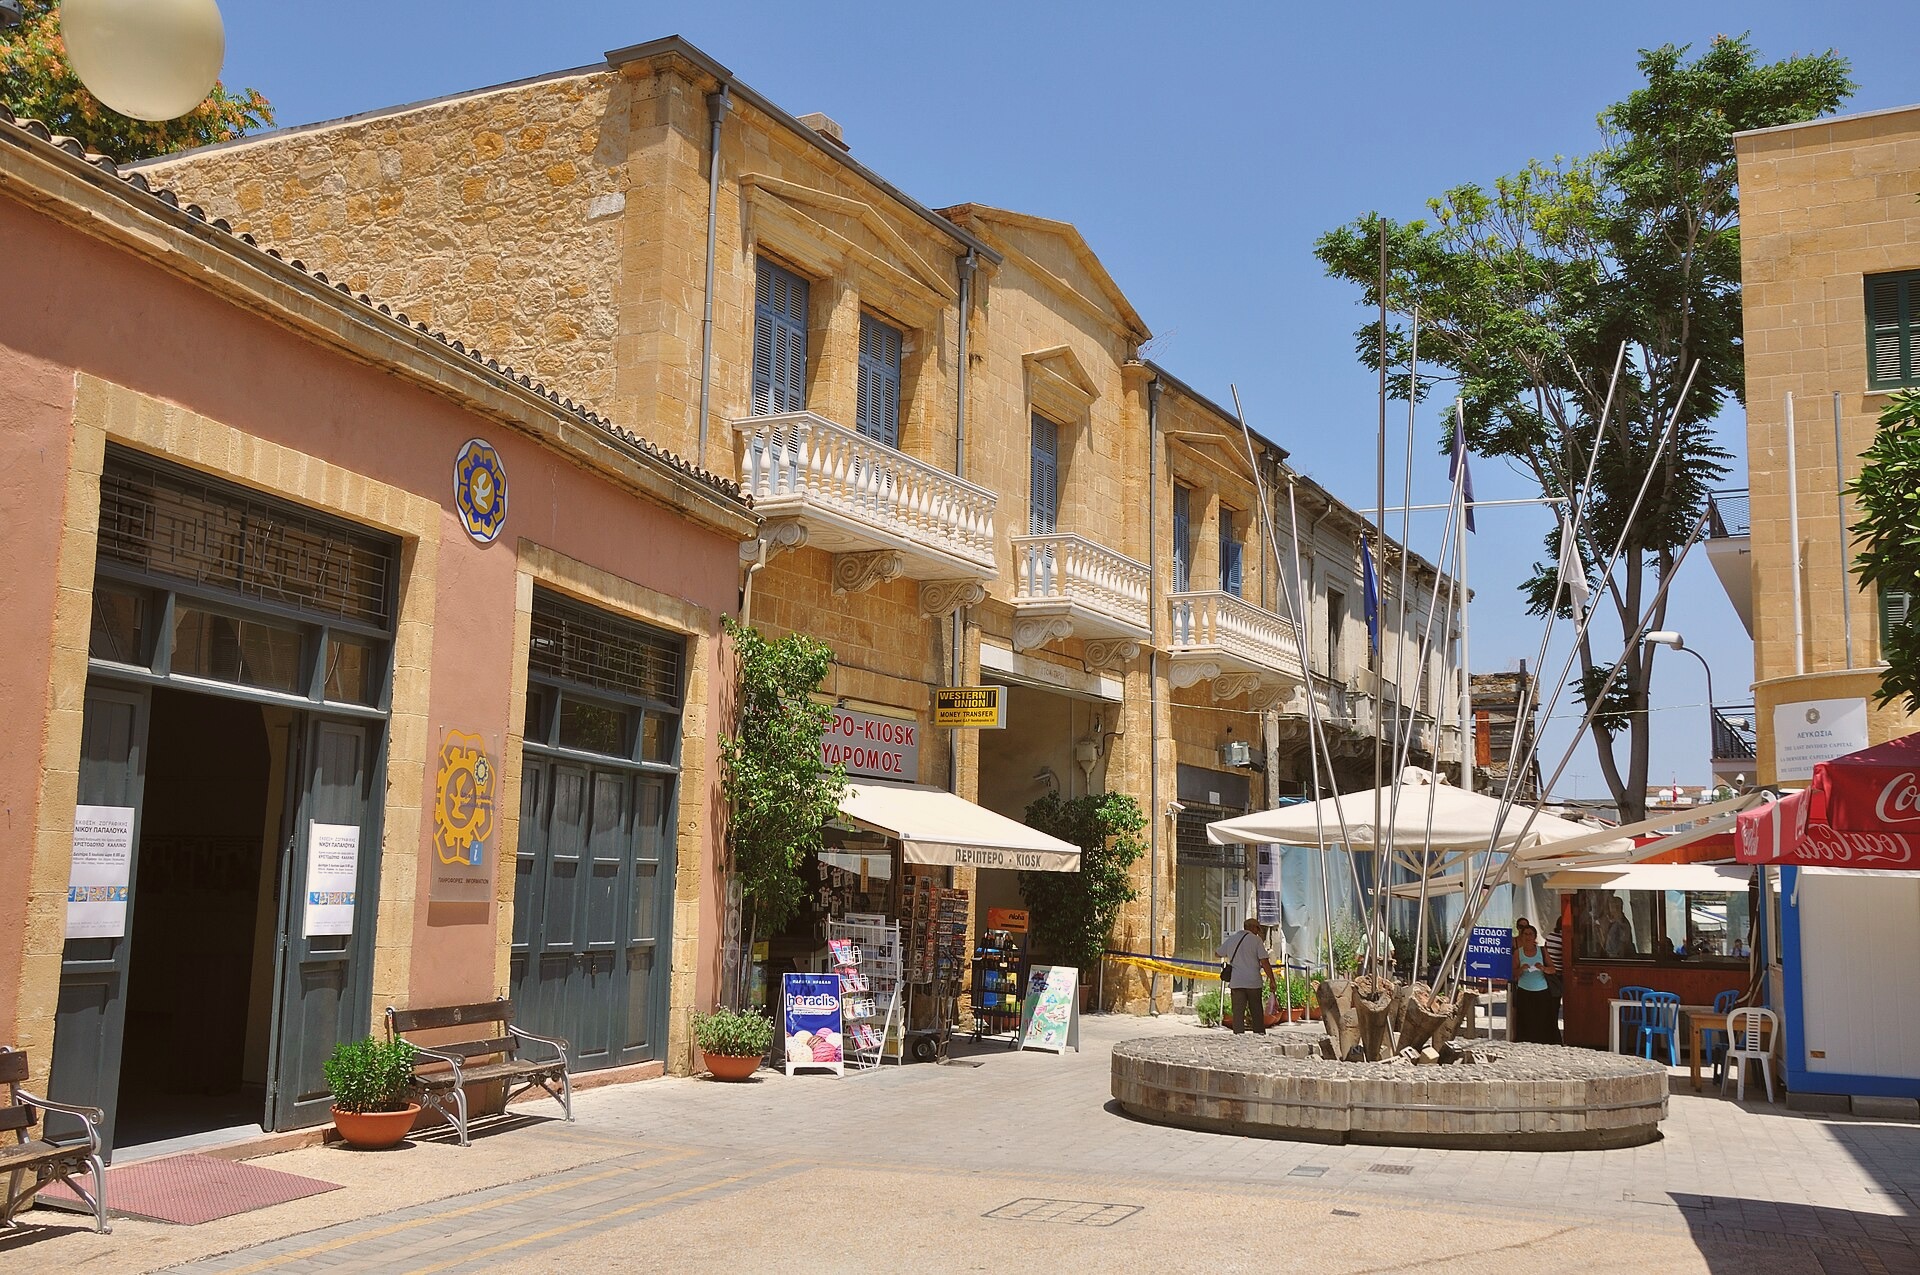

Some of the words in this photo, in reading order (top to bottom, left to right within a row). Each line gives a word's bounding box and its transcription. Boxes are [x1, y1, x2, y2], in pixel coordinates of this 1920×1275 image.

[939, 691, 986, 700] WESTERN
[954, 699, 986, 708] UNION
[821, 714, 915, 746] ΕΡΟ-KIOSK
[1797, 730, 1833, 739] ΛΕΥΚΩΣΙΑ
[821, 742, 903, 773] ΥΔΡΟΜΟΣ
[955, 848, 1004, 865] ΠΕΡΙΠΤΕΡΟ
[1016, 853, 1042, 868] KIOSK
[1008, 913, 1025, 921] Aloha
[1473, 928, 1507, 937] ΕΙΣΟΔΟΣ
[1468, 945, 1511, 955] ENTRANCE
